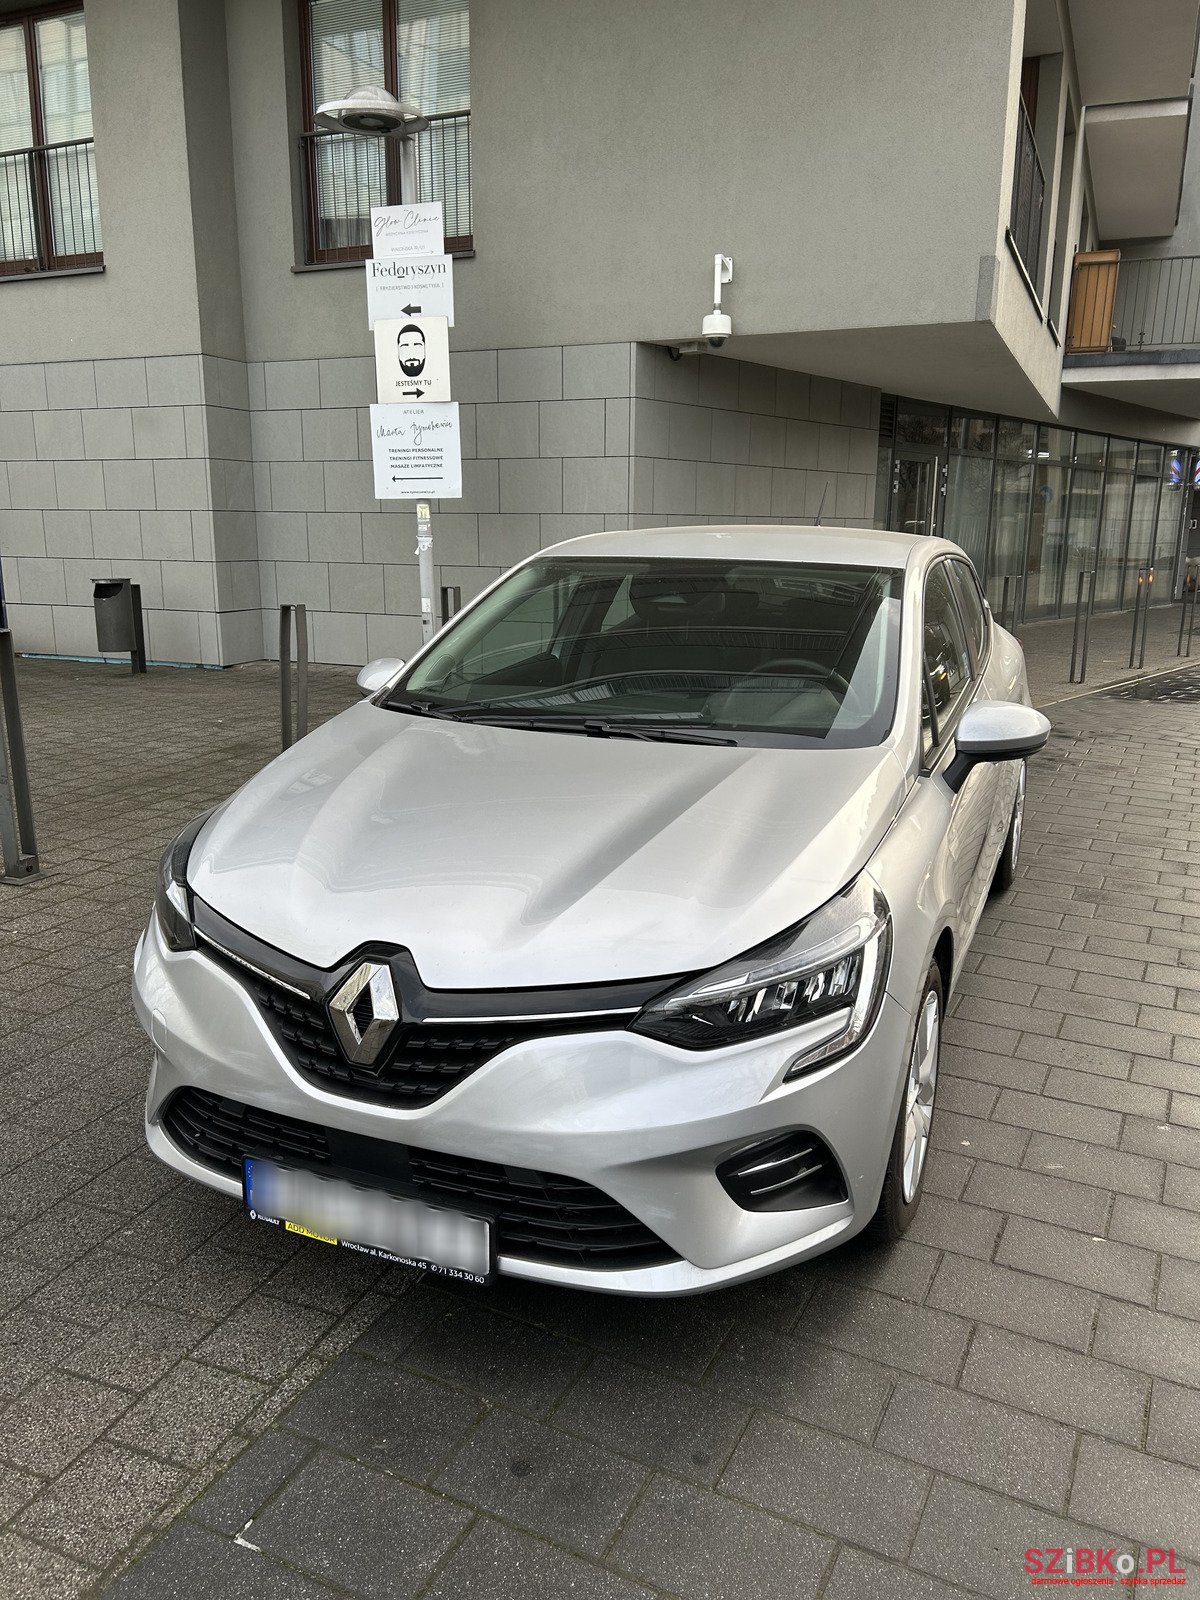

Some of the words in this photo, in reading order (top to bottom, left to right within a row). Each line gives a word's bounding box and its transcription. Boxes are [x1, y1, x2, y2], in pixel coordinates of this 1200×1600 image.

[372, 261, 447, 281] Fedoryszyn
[395, 379, 423, 387] JESTEŚMY
[287, 1222, 305, 1234] ADD
[341, 1240, 370, 1254] Wrocław
[370, 1248, 378, 1257] al.
[378, 1250, 417, 1267] Karkonoska
[417, 1261, 427, 1270] 45
[438, 1264, 448, 1275] 71
[448, 1268, 463, 1279] 334
[463, 1272, 474, 1281] 30
[474, 1275, 485, 1284] 60
